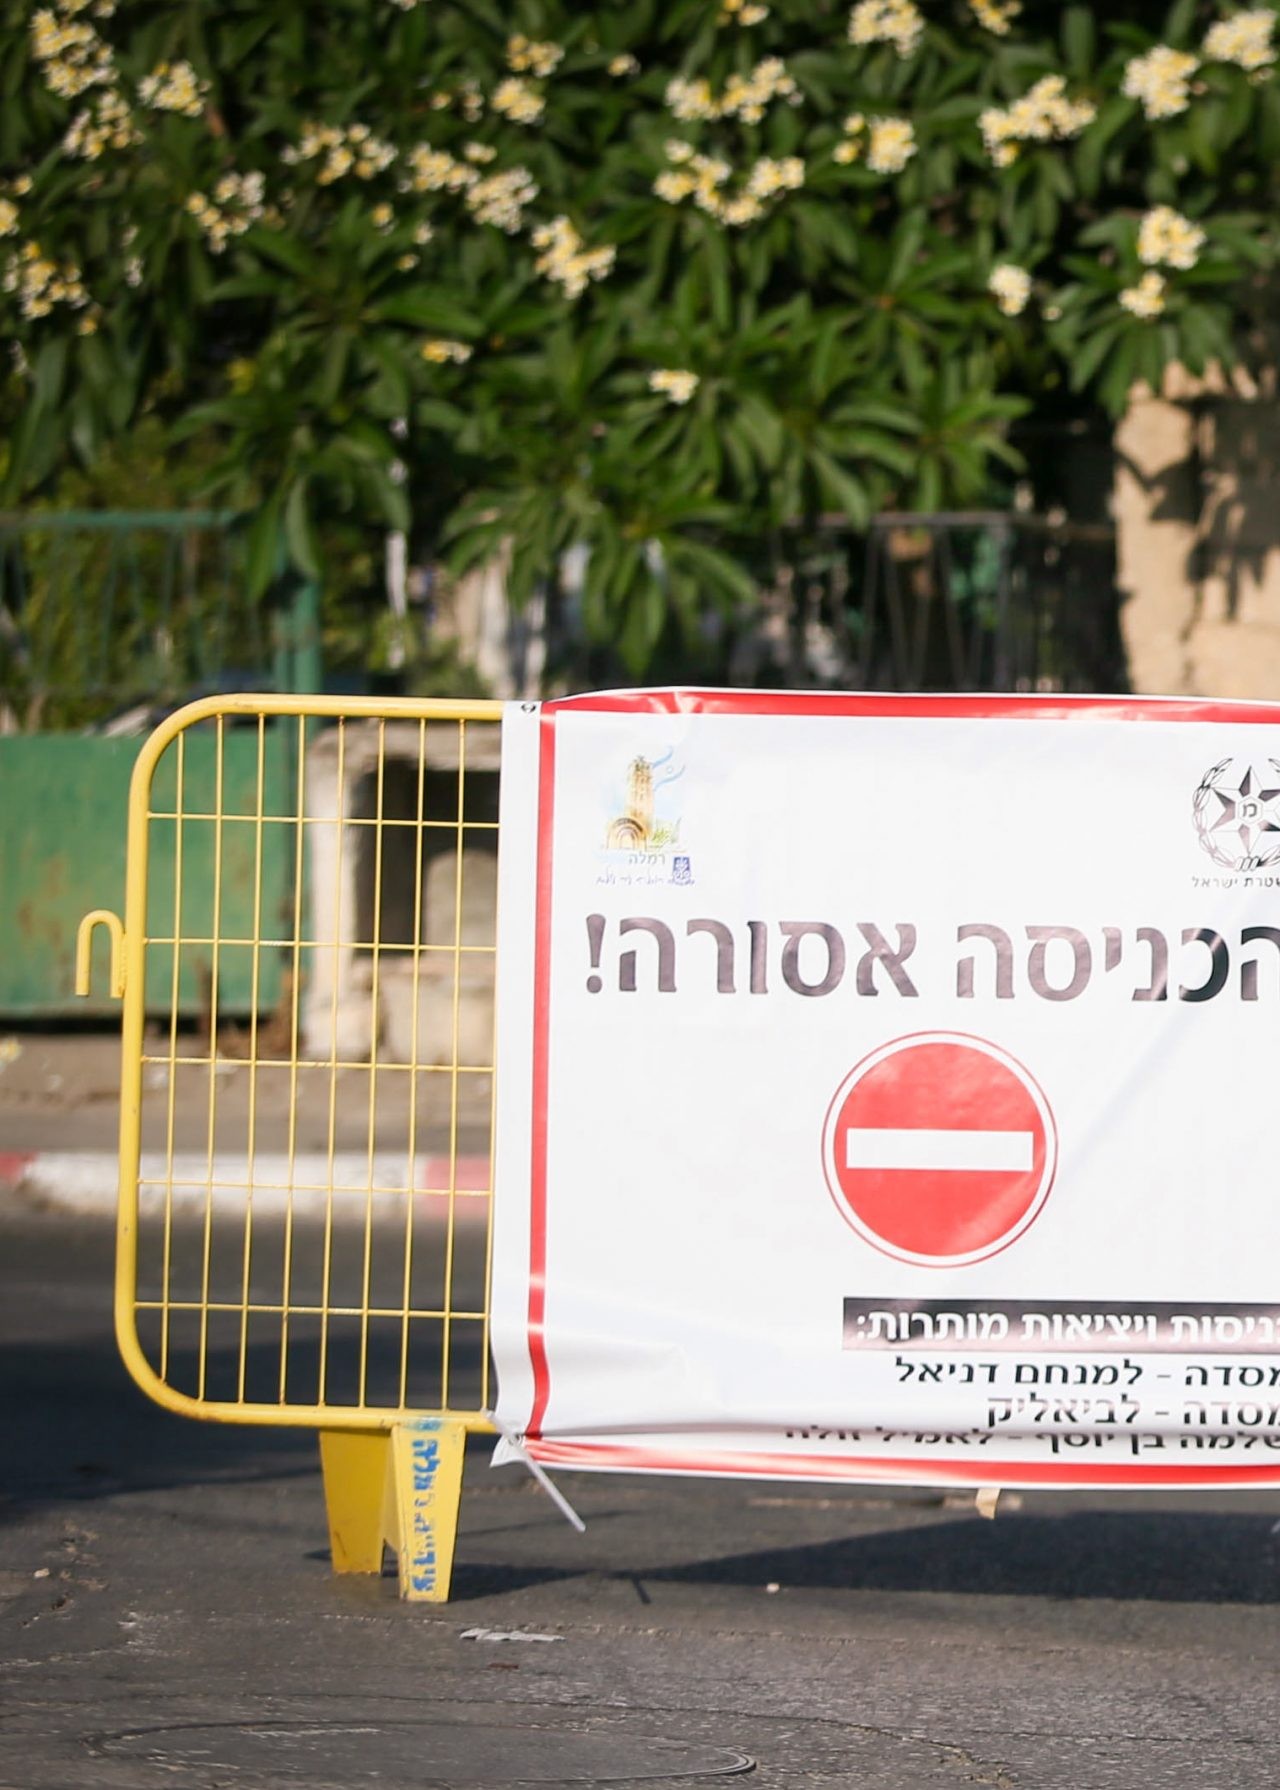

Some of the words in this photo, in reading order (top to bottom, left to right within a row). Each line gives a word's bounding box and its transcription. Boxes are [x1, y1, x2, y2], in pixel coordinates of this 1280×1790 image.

[1192, 876, 1238, 889] ישראל
[585, 913, 920, 998] אסורה!
[856, 1308, 1010, 1342] מותרות:
[1020, 1311, 1157, 1345] ויציאות
[896, 1356, 998, 1384] דניאל
[1014, 1358, 1143, 1386] למנחם
[987, 1392, 1141, 1428] לביאליק
[1034, 1431, 1116, 1454] יוסף
[1129, 1432, 1166, 1456] בן
